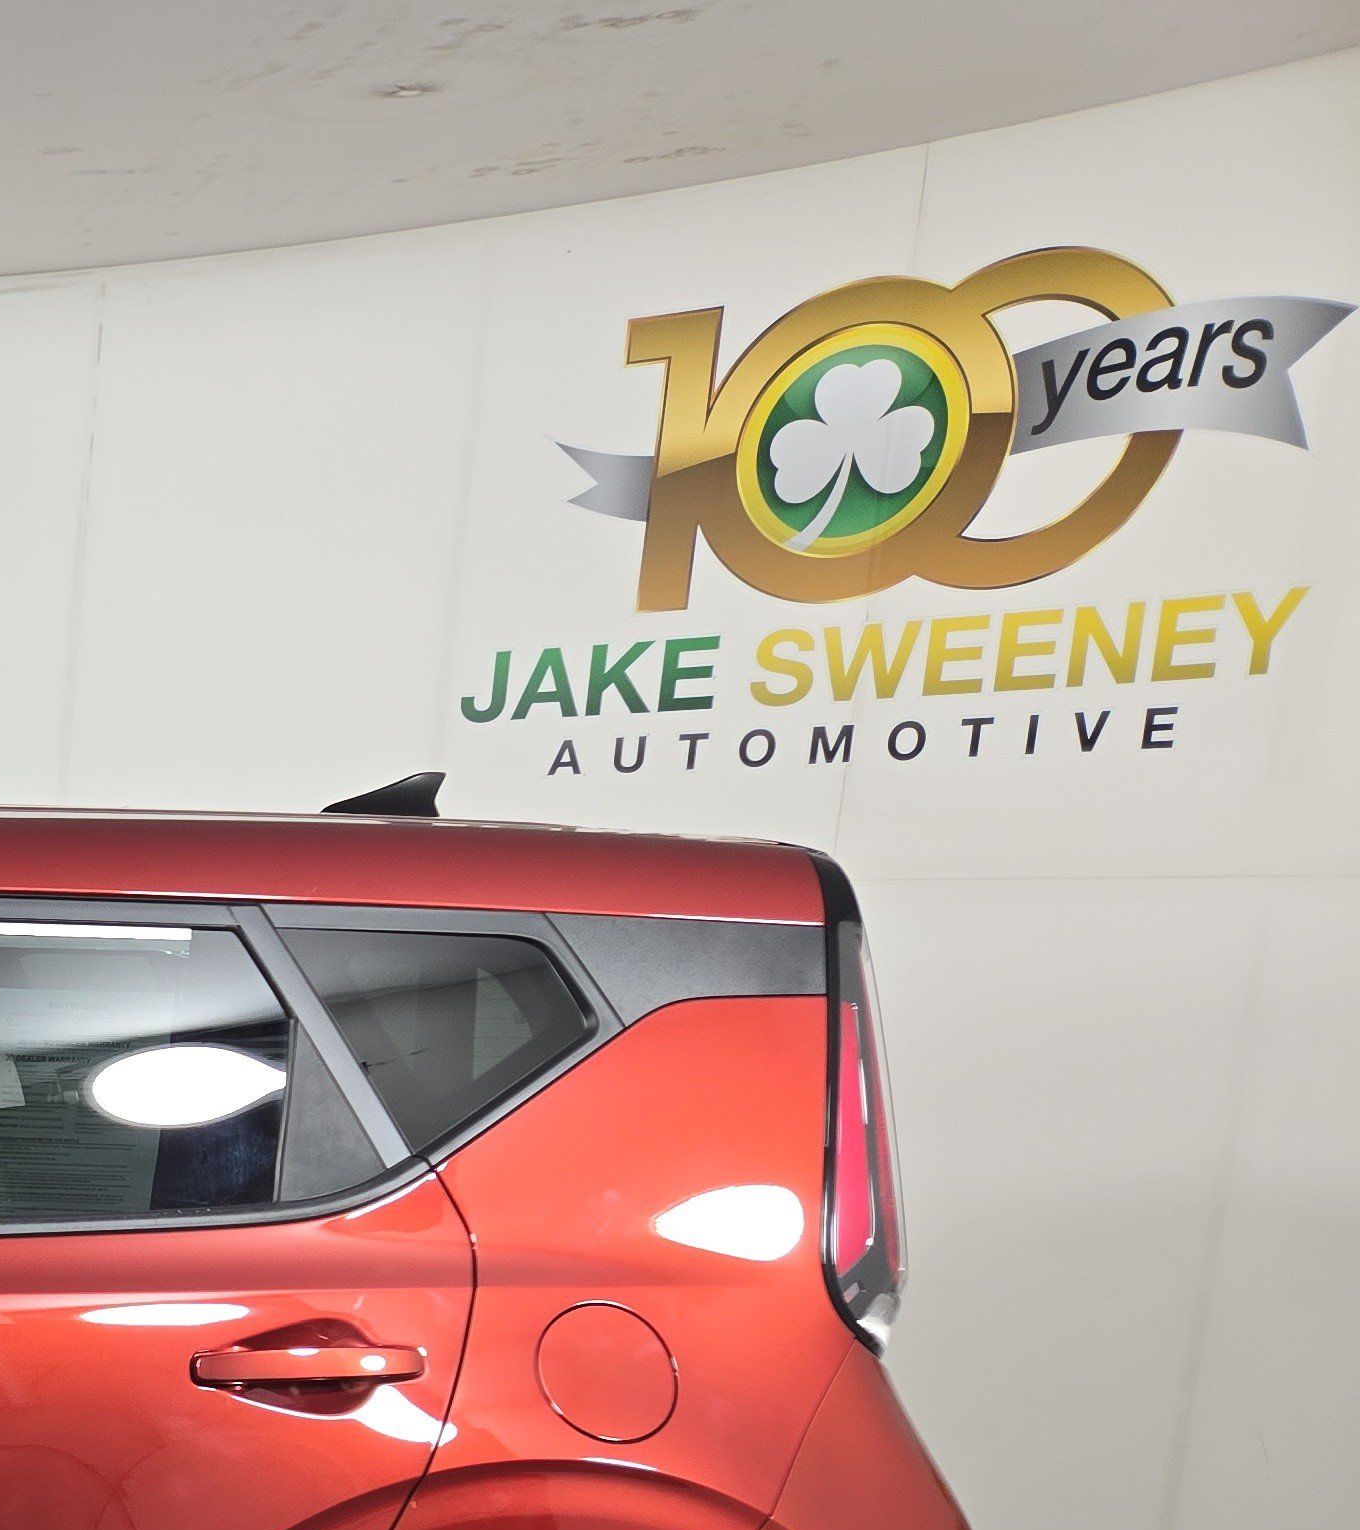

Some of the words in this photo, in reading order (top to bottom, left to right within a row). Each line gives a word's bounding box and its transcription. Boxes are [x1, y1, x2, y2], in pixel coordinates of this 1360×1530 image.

[626, 245, 1185, 613] 100
[1031, 317, 1275, 437] years
[460, 633, 722, 724] JAKE
[749, 585, 1311, 708] SWEENEY
[547, 705, 1180, 778] AUTOMOTIVE
